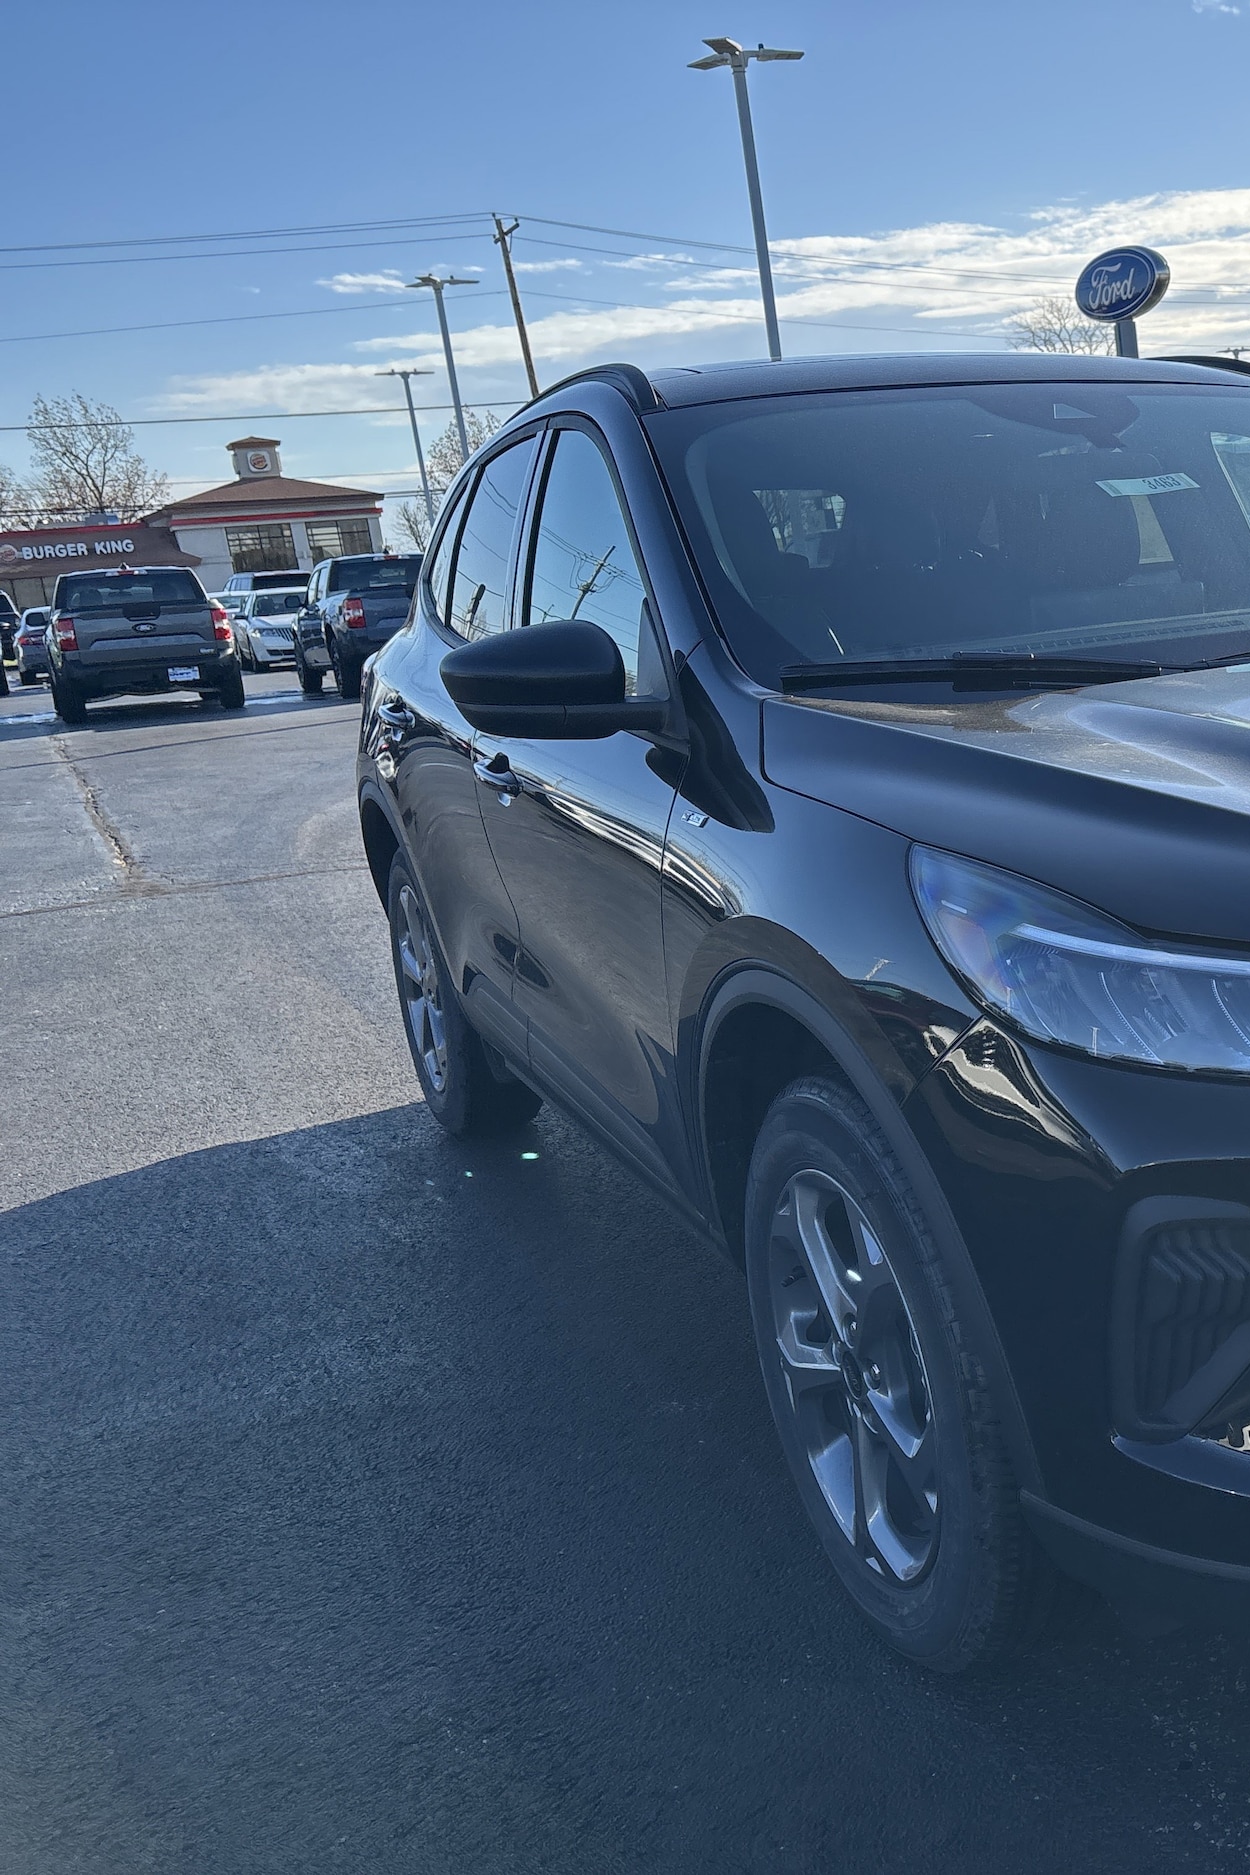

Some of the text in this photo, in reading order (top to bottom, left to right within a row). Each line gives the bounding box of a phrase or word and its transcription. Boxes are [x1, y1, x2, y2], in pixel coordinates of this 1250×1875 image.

[1089, 262, 1137, 310] Ford
[1142, 475, 1181, 490] 3463
[21, 542, 89, 560] BURGER
[94, 538, 135, 555] KING
